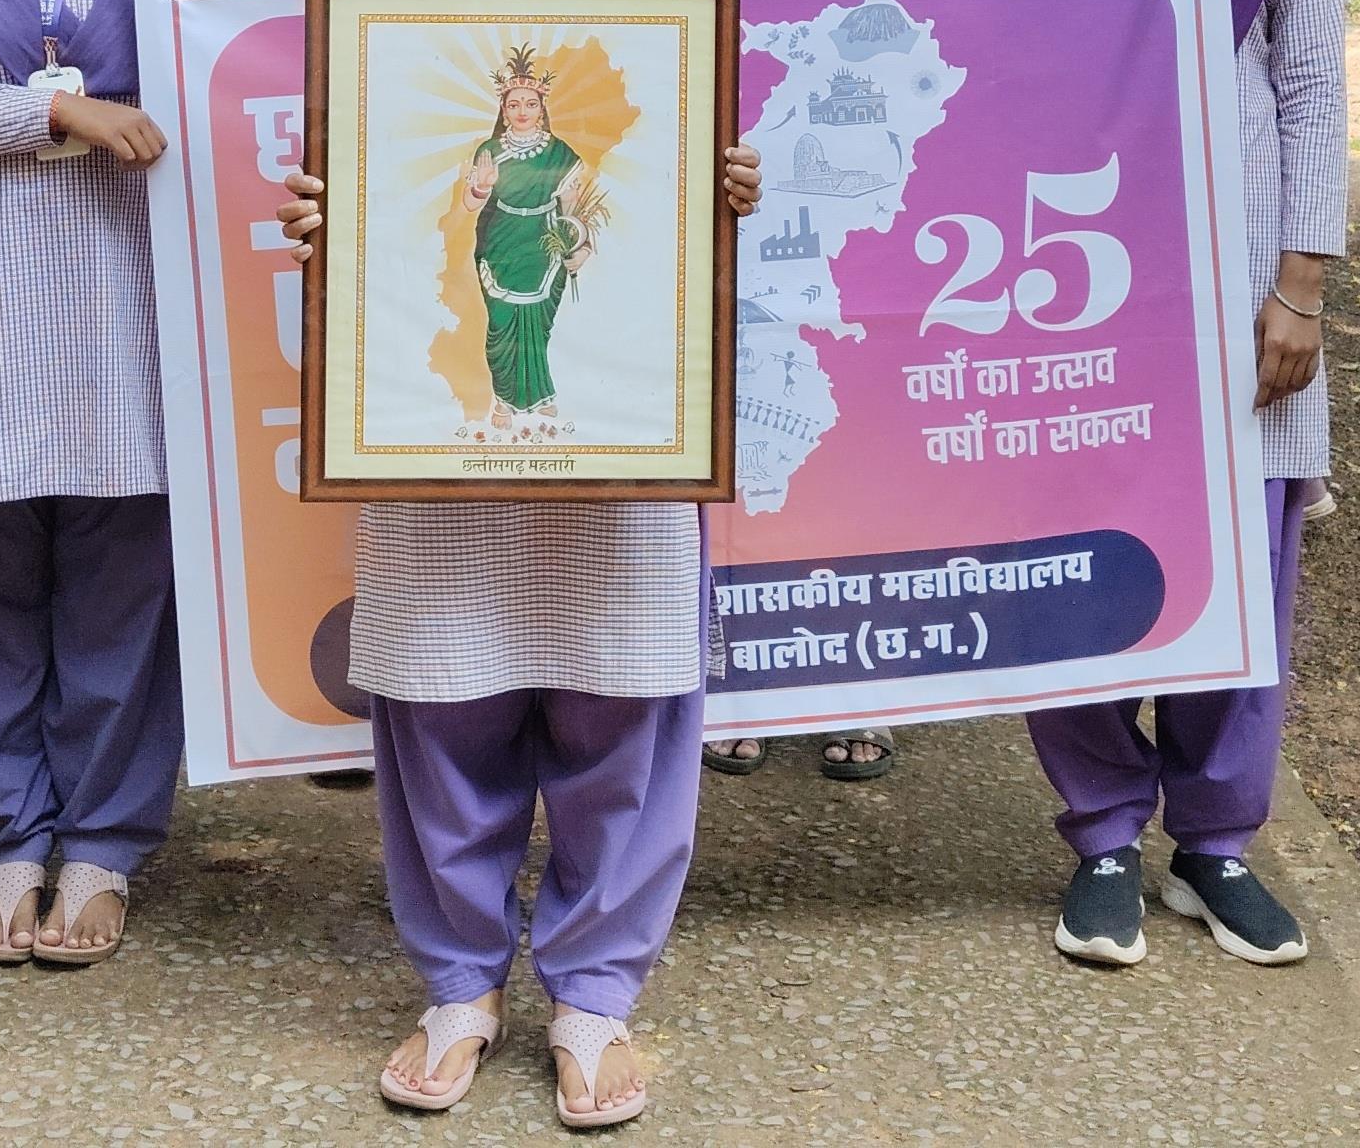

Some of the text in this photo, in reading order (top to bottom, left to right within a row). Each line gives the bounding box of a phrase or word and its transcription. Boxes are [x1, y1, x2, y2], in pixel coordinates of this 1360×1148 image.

[915, 152, 1131, 337] 25
[902, 347, 1117, 402] वर्षों का उत्सव
[922, 403, 1153, 464] वर्षों का संकल्प
[462, 455, 576, 475] छत्तीसगढ़ महतारी
[716, 551, 1093, 616] शासकीय महाविद्यालय
[730, 612, 989, 672] बालोद (छ.ग.)
